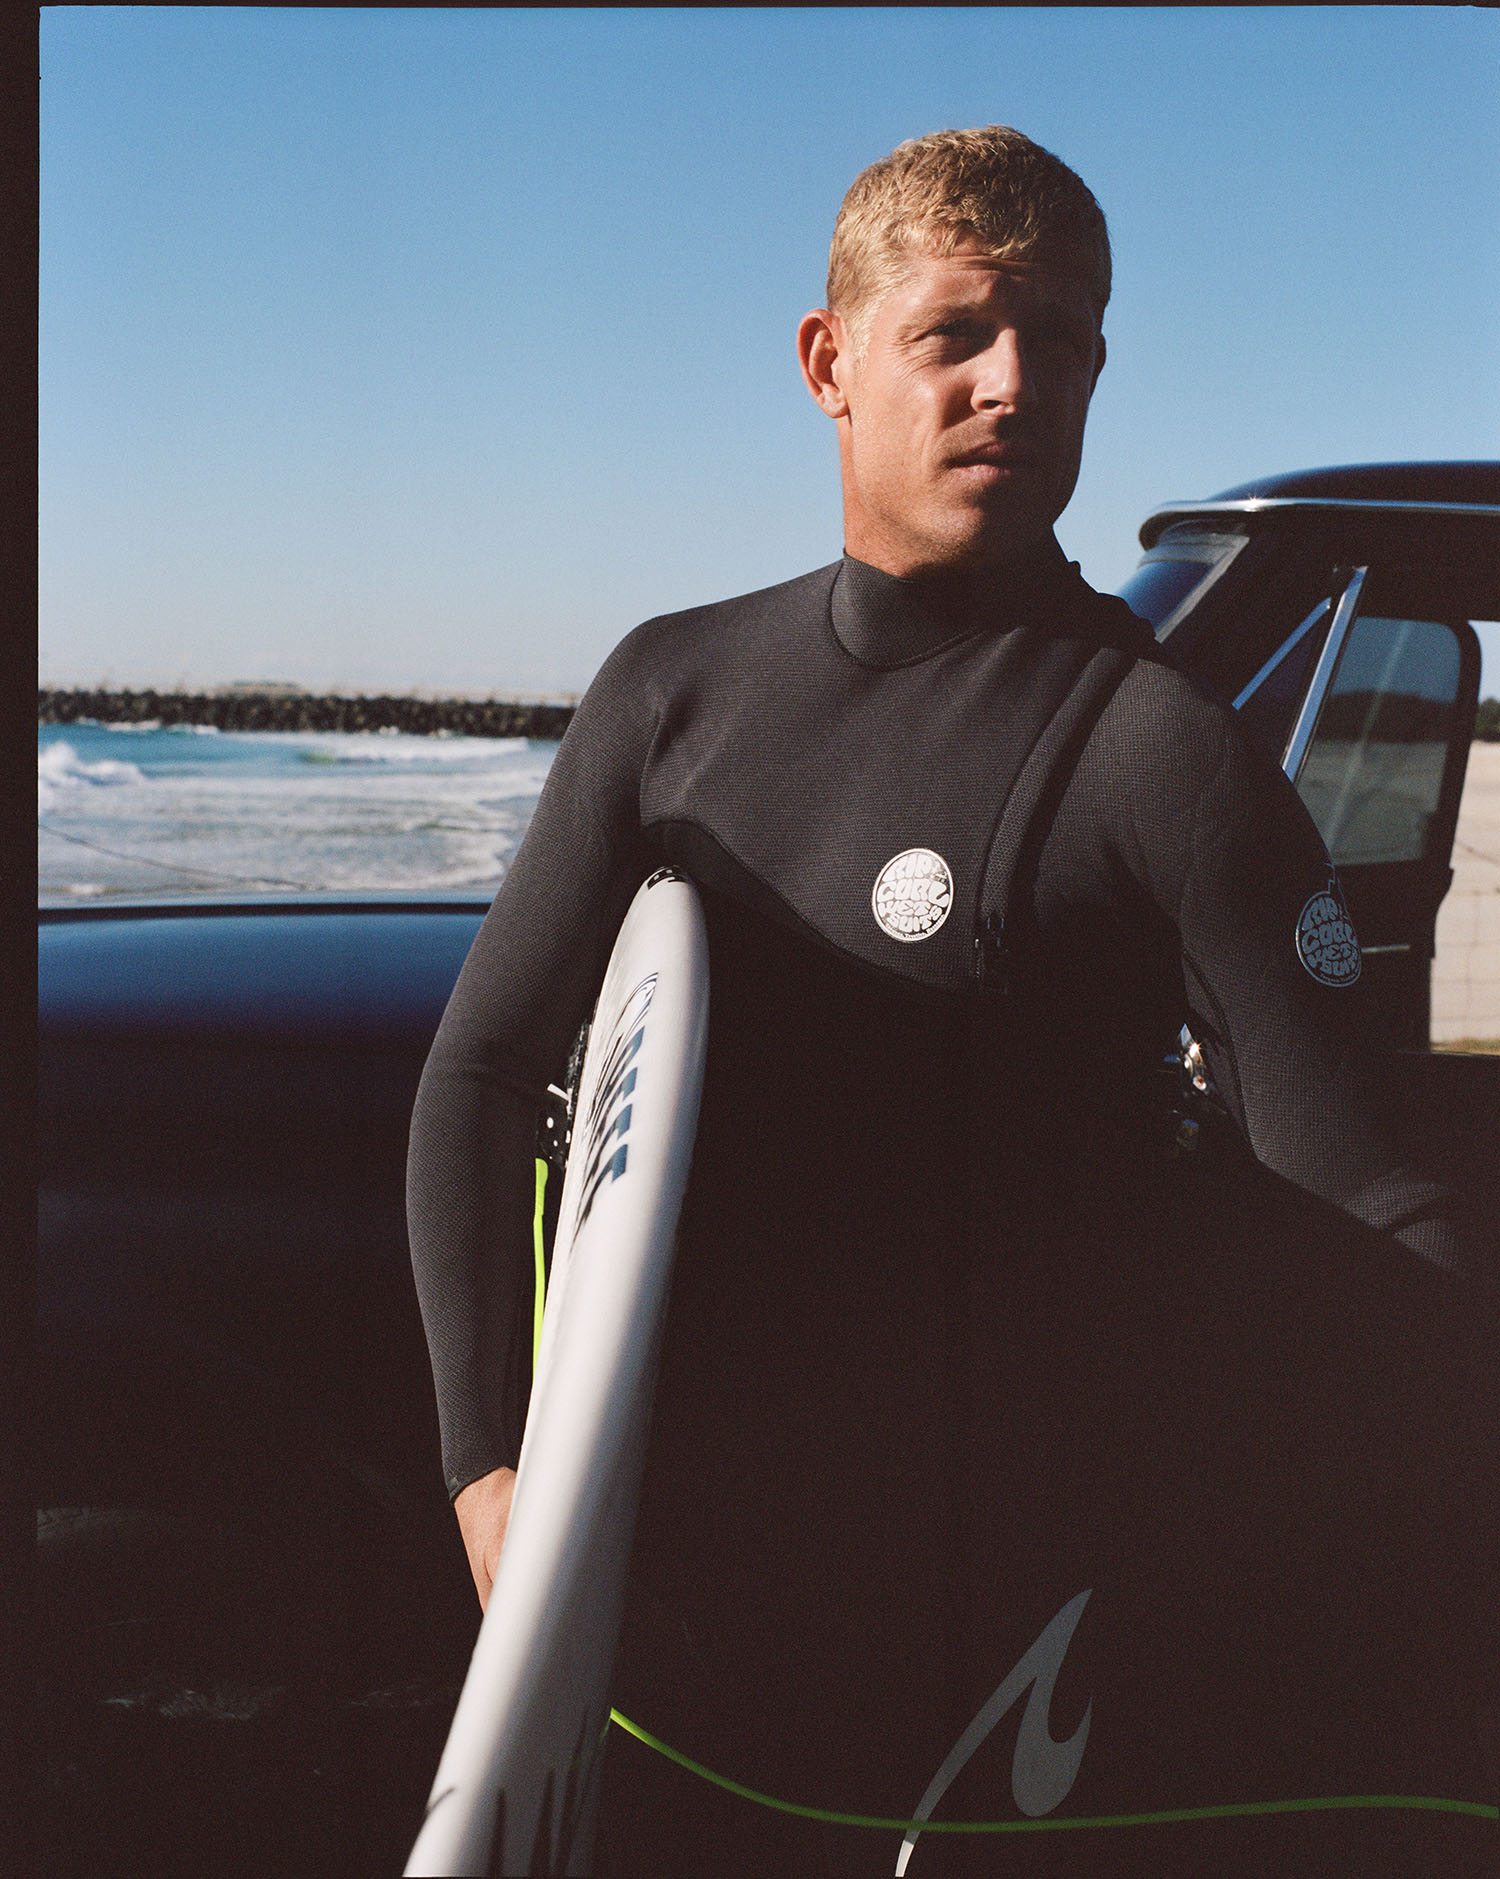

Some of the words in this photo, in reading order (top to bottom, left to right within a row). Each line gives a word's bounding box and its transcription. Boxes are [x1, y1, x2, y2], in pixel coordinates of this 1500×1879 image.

[882, 853, 933, 881] RIP
[877, 878, 950, 908] CURL
[878, 899, 931, 917] WET
[885, 906, 943, 932] SUITS
[1302, 897, 1338, 930] RIP
[1302, 920, 1358, 955] CURL
[1307, 942, 1352, 969] WET
